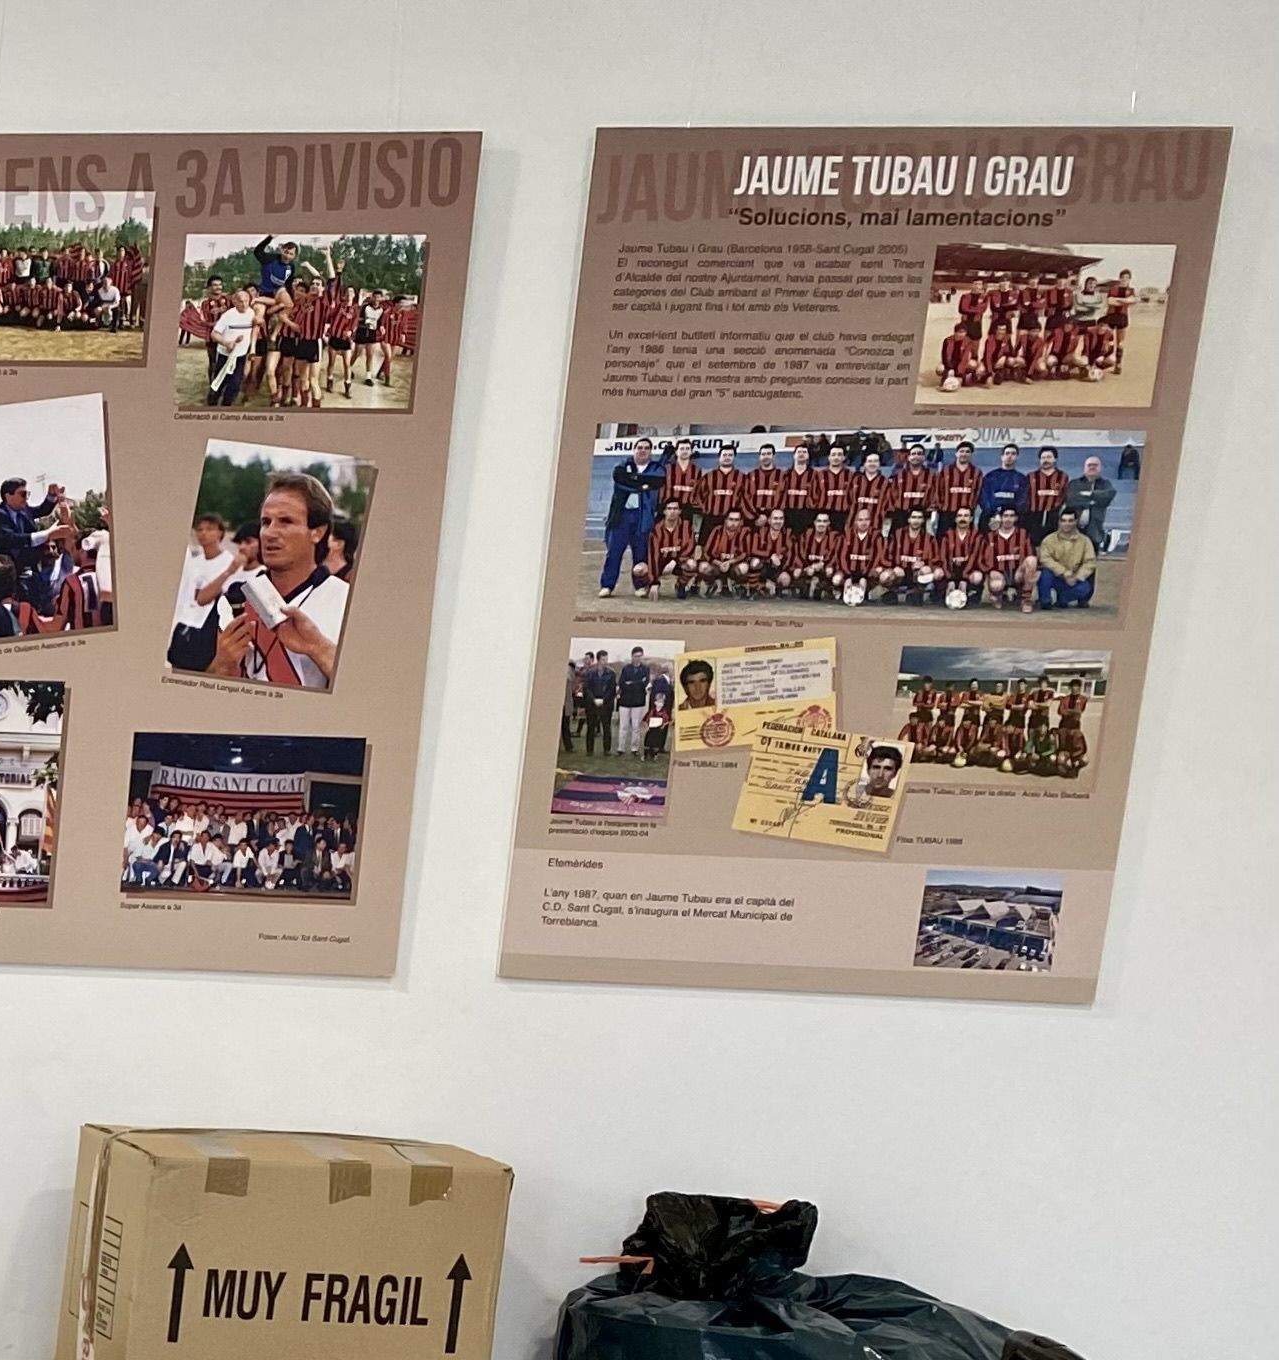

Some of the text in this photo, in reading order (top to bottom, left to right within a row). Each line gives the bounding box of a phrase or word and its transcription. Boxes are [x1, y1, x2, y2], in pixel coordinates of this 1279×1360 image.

[123, 153, 155, 219] A
[176, 150, 248, 219] 3A
[734, 156, 1075, 197] JAUME TUBAU I GRAU
[860, 209, 898, 228] mai
[212, 776, 248, 792] SANT
[548, 857, 604, 870] Efemèrides
[542, 901, 563, 913] C.D.
[567, 903, 590, 914] Sant
[594, 905, 624, 918] Cugat,
[682, 908, 690, 918] el
[694, 909, 727, 920] Mercat
[729, 910, 776, 923] Municipal
[780, 912, 793, 921] de
[203, 1269, 429, 1327] MUY FRAGIL
